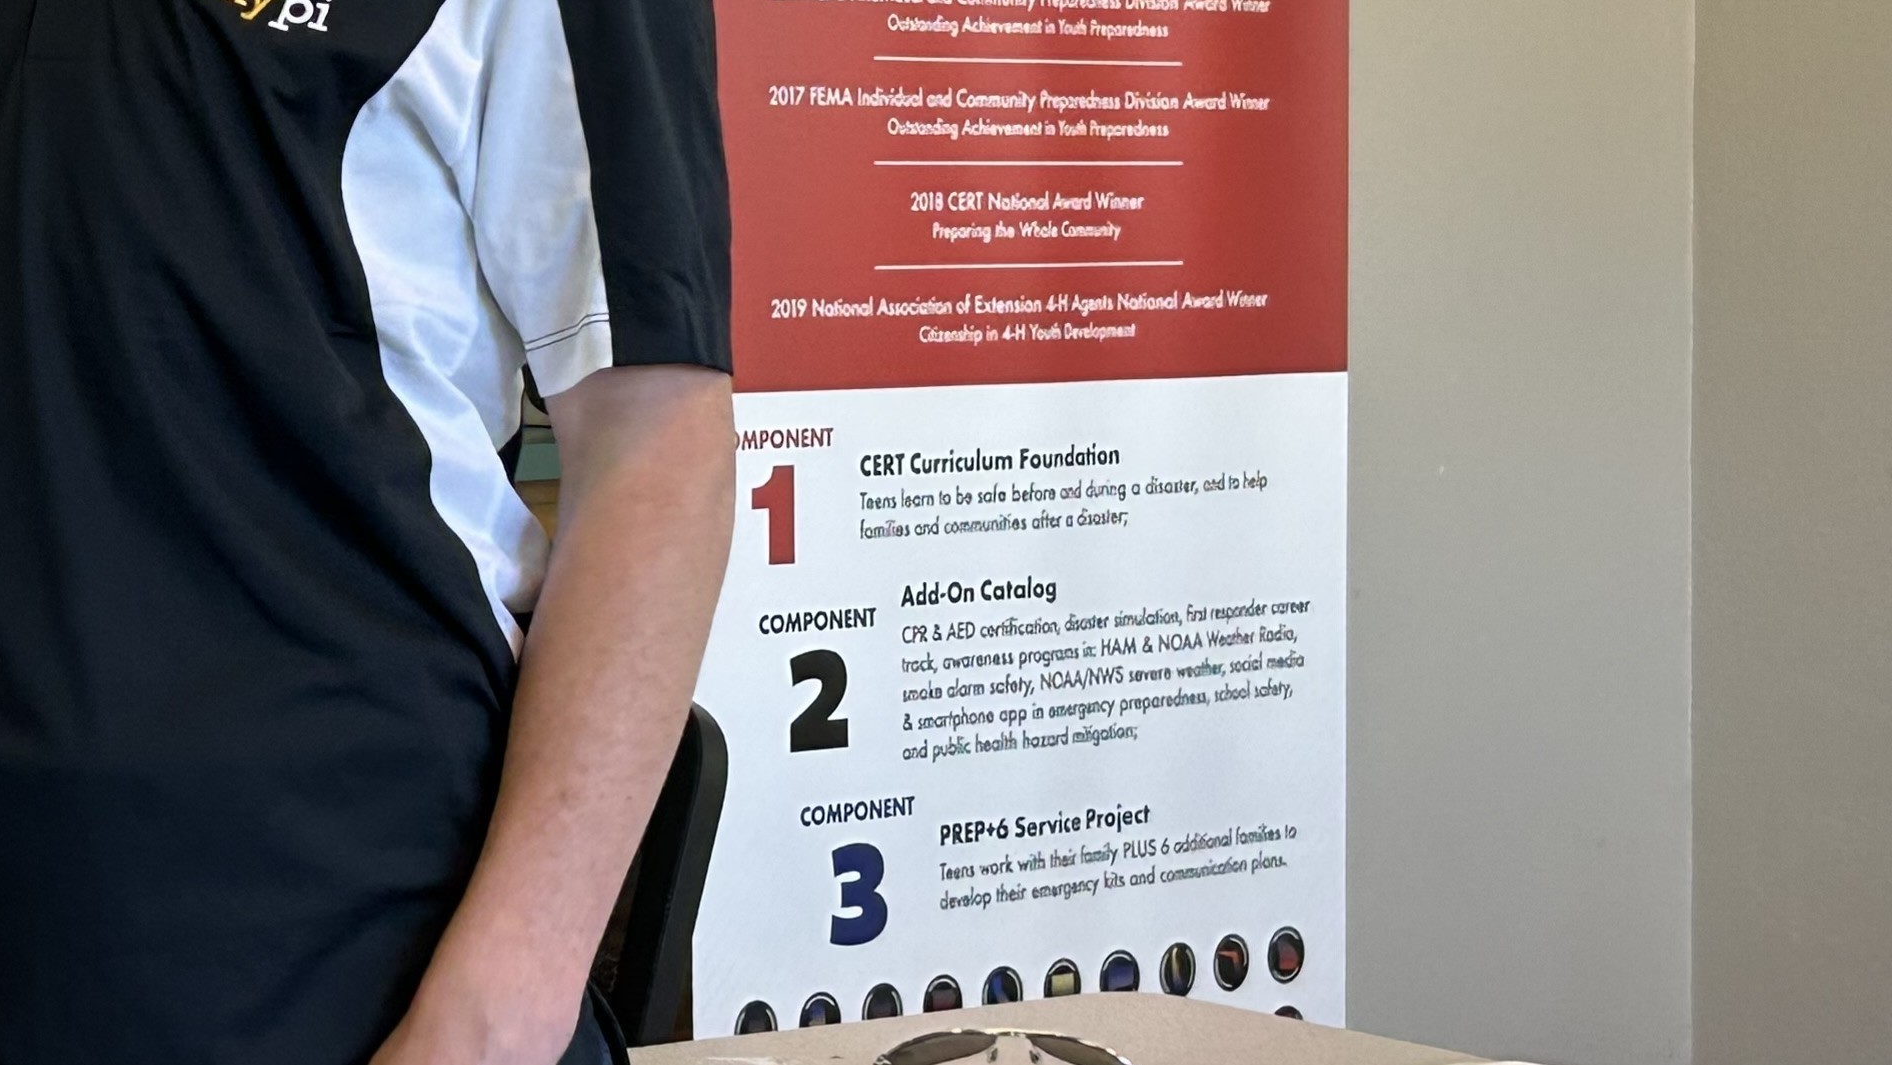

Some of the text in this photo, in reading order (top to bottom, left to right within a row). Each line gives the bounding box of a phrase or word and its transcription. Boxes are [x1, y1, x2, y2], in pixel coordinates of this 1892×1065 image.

[768, 84, 805, 106] 2017
[809, 85, 854, 106] FEMA
[947, 190, 984, 211] CERT
[770, 297, 808, 318] 2019
[974, 294, 1042, 314] Extension
[733, 427, 834, 453] MPONENT
[859, 442, 1120, 477] CERT Curriculum Foundation
[859, 491, 897, 510] Teens
[955, 484, 973, 505] be
[1011, 481, 1056, 502] before
[751, 464, 795, 565] 1
[913, 514, 939, 536] and
[900, 575, 1057, 607] Add-On Catalog
[758, 607, 877, 634] COMPONENT
[931, 623, 942, 642] &
[945, 620, 976, 641] AED
[942, 651, 1014, 670] awareness
[1100, 636, 1137, 657] HAM
[1141, 635, 1153, 653] &
[1158, 631, 1203, 652] NOAA
[789, 648, 849, 753] 2
[902, 712, 913, 731] &
[998, 708, 1027, 727] app
[901, 738, 928, 760] and
[799, 795, 915, 826] COMPONENT
[939, 804, 1150, 846] PREP+6 Service Project
[1122, 838, 1157, 859] PLUS
[1160, 836, 1170, 855] 6
[1129, 864, 1155, 886] and
[829, 842, 889, 946] 3
